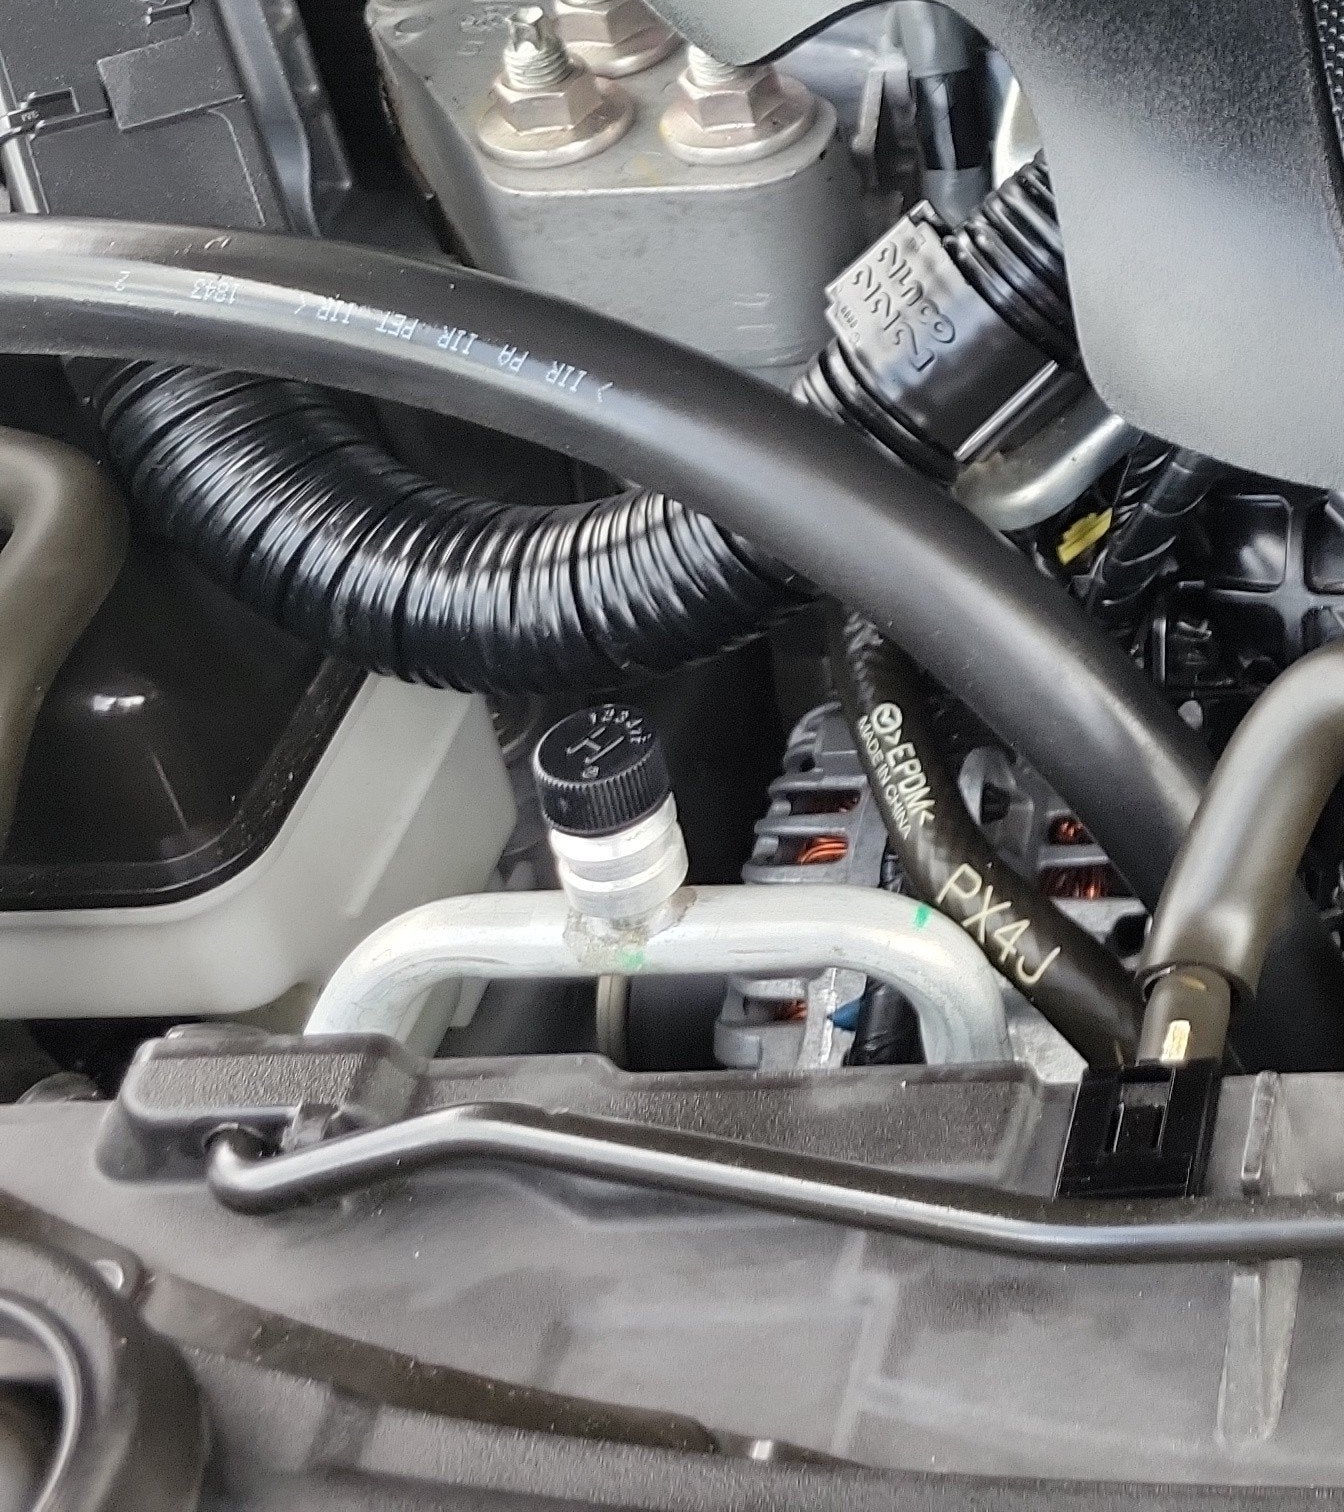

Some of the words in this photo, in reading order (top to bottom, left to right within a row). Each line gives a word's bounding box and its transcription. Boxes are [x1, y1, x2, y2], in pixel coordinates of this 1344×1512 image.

[375, 311, 419, 340] PET
[859, 714, 884, 767] MADE
[876, 763, 892, 788] IN
[885, 784, 912, 840] CHINA
[936, 863, 1061, 985] PX4J
